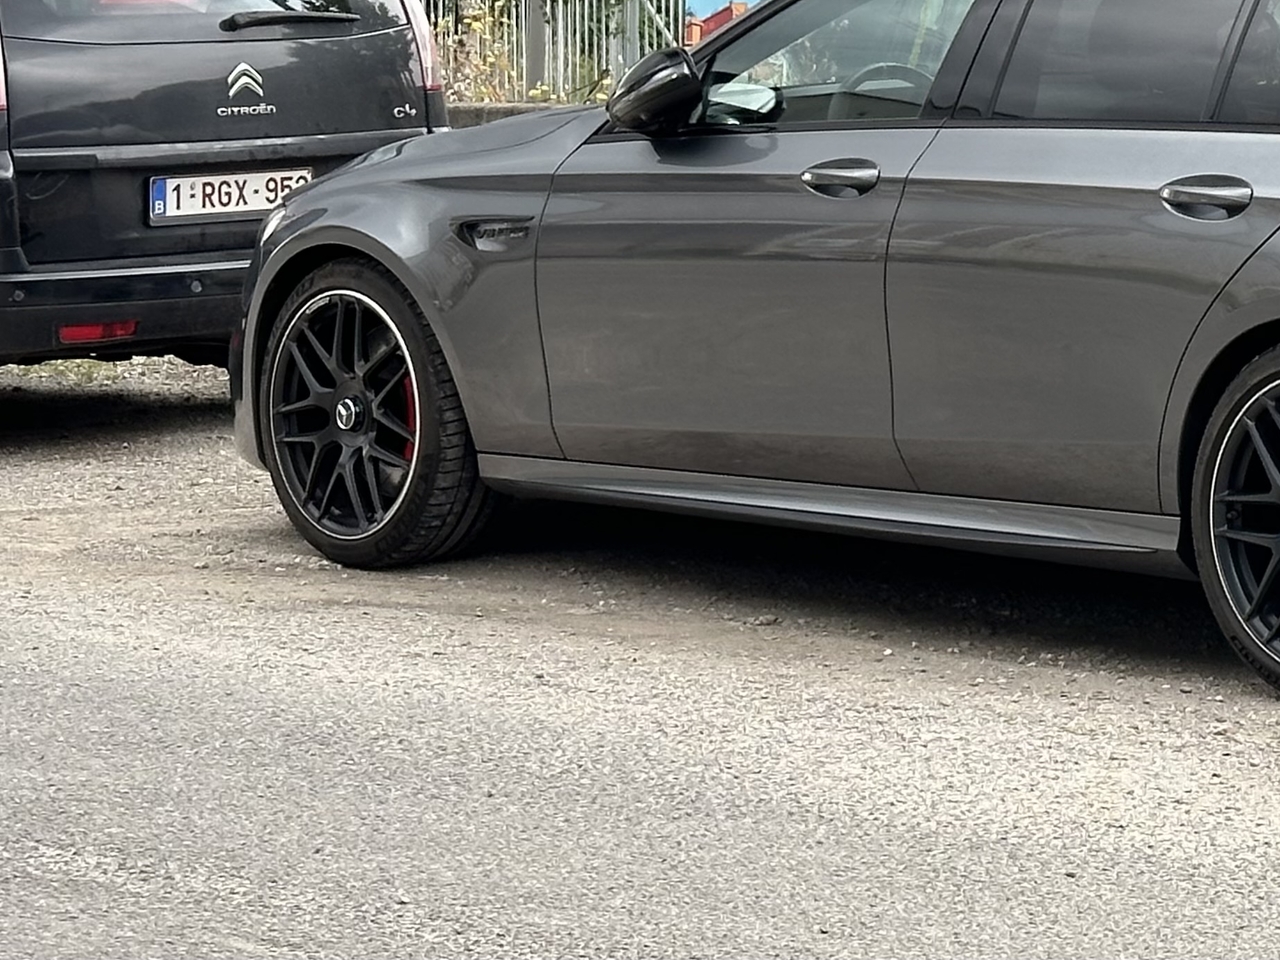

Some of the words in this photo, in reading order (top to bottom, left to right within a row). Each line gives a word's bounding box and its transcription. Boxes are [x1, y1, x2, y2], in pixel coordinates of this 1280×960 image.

[217, 103, 276, 117] CITROËN
[394, 103, 417, 118] C4
[154, 200, 165, 214] B
